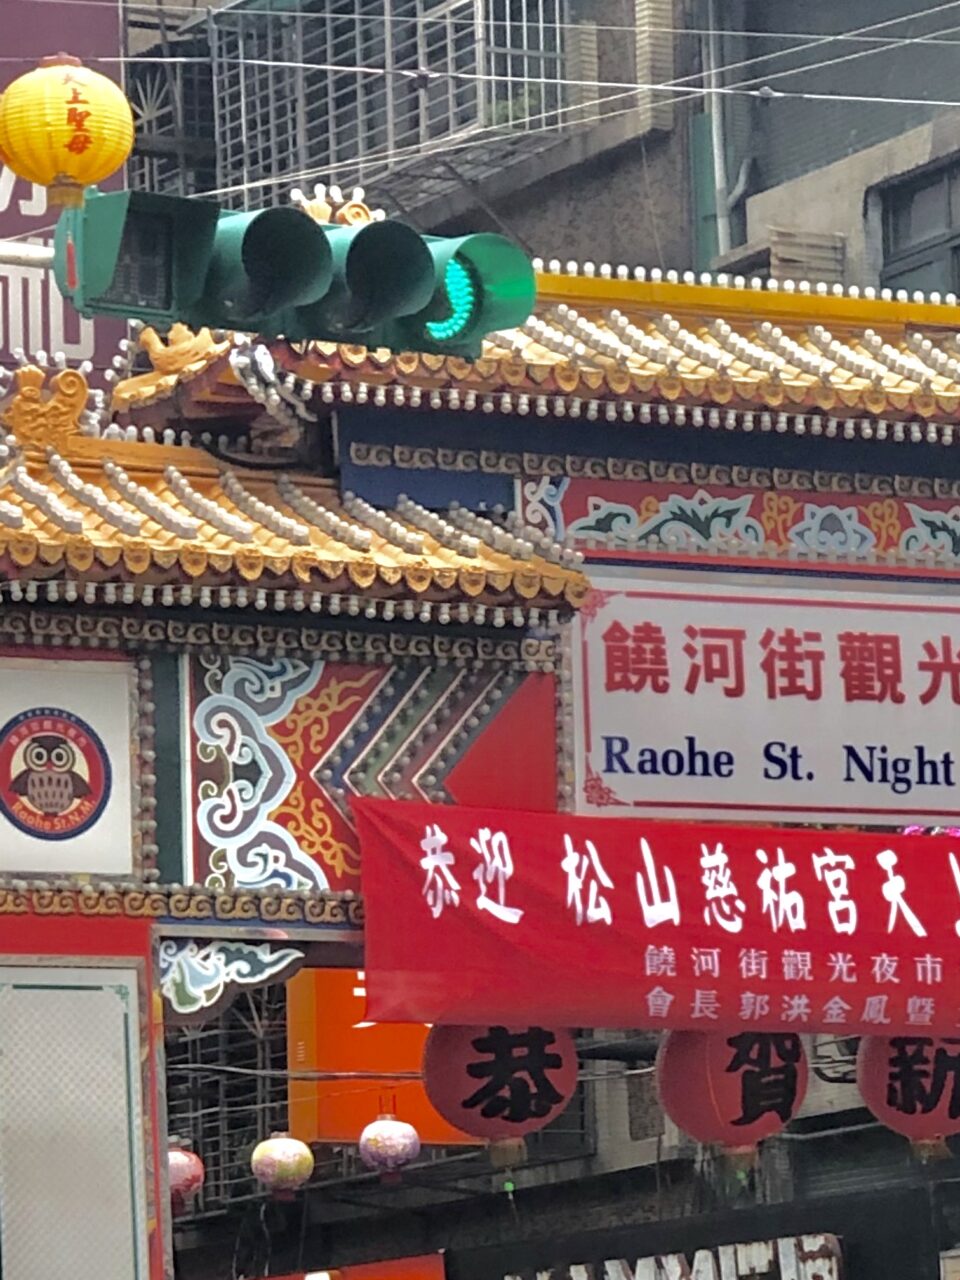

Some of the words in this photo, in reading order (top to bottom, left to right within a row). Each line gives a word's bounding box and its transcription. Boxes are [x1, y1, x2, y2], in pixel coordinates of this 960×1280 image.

[62, 73, 94, 155] 天上聖母
[602, 736, 735, 779] Raohe
[762, 741, 814, 782] St.
[843, 745, 955, 794] Night
[419, 824, 525, 924] 恭迎
[462, 1026, 564, 1122] 恭
